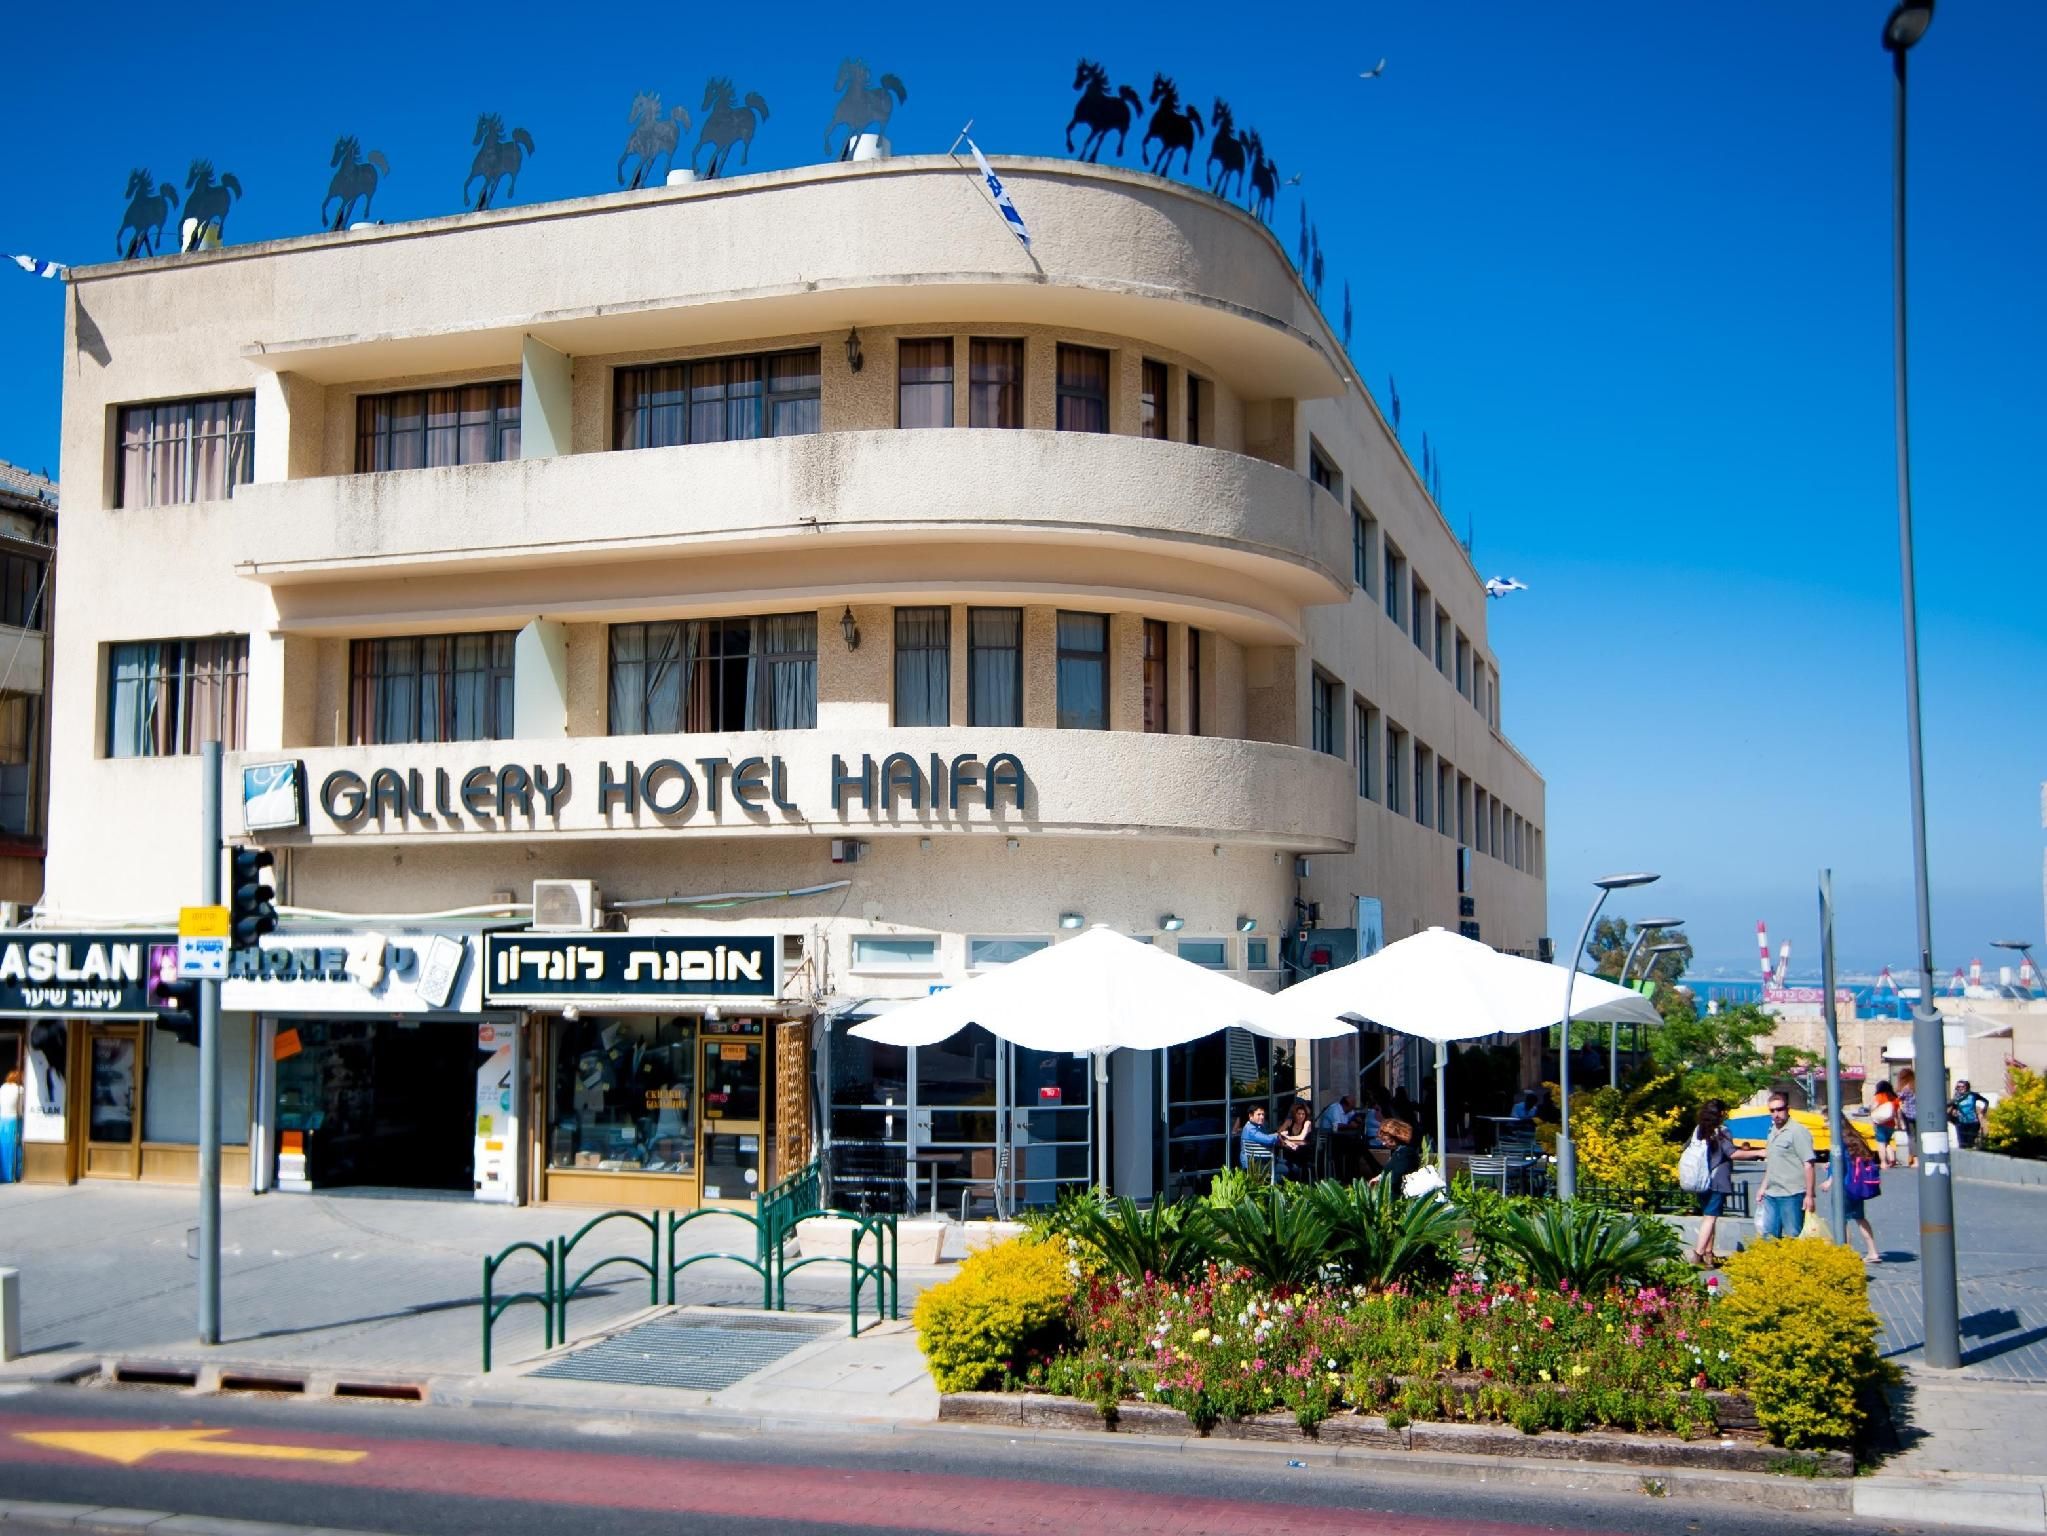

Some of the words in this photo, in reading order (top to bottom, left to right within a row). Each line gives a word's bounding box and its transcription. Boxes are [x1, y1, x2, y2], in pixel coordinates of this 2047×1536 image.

[320, 762, 566, 822] GALLERY
[599, 755, 798, 815] HOTEL
[831, 752, 1026, 810] HAIFA
[0, 942, 142, 981] ASLAN
[497, 945, 604, 986] לונדון
[623, 945, 763, 981] אופנת
[20, 988, 67, 1008] שיער
[72, 988, 122, 1009] עיצוב
